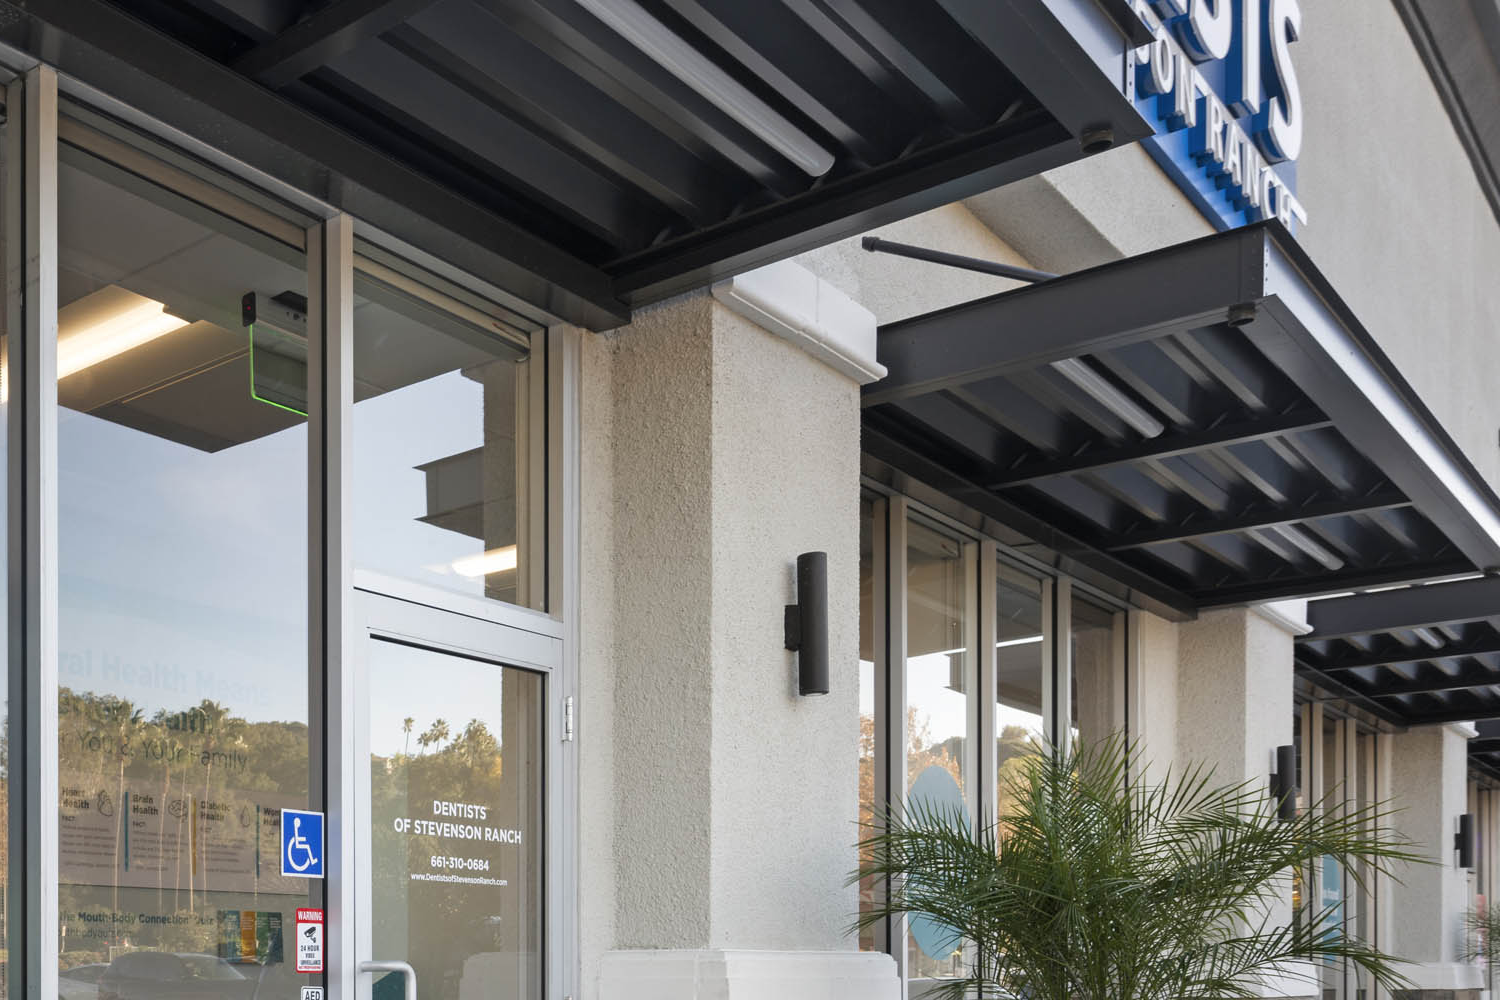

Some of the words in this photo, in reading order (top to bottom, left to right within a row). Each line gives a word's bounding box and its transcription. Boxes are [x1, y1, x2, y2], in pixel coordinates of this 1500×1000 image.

[191, 747, 249, 770] Family
[433, 800, 487, 820] DENTISTS
[394, 817, 412, 833] OF
[414, 820, 482, 841] STEVENSON
[484, 826, 522, 844] RANCH
[430, 855, 489, 871] 661-310-0684
[297, 911, 322, 921] WARNING
